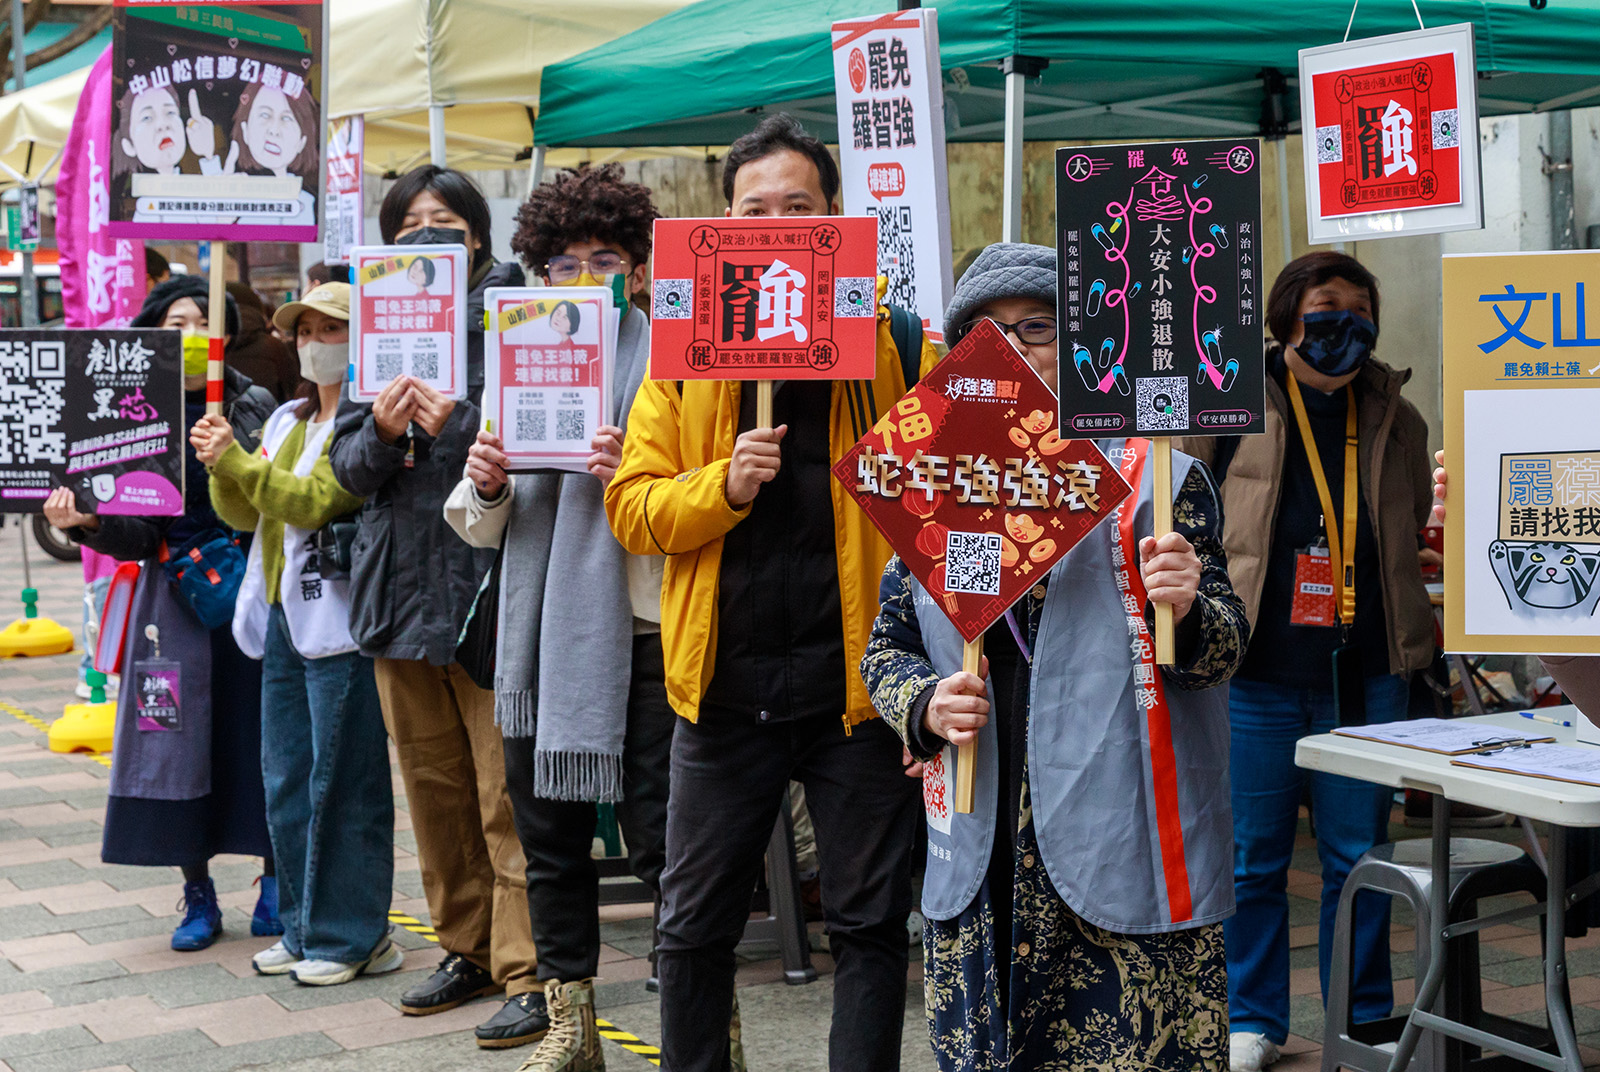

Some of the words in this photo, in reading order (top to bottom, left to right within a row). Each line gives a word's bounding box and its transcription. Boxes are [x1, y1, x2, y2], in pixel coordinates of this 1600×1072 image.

[867, 36, 911, 90] 罷免
[1355, 73, 1411, 91] 政治小強人喊打
[1414, 67, 1428, 86] 安
[1338, 79, 1351, 98] 大
[851, 97, 917, 150] 羅智強
[1070, 158, 1088, 177] 大
[1127, 148, 1189, 168] 罷免
[1232, 150, 1250, 169] 安
[1344, 185, 1356, 204] 罷
[1420, 177, 1434, 196] 強
[694, 229, 715, 251] 大
[722, 233, 808, 246] 政治小強人喊打
[814, 228, 836, 250] 安
[1067, 230, 1080, 332] 罷免就罷羅智強
[1240, 223, 1253, 325] 政治小強人喊打
[699, 273, 711, 326] 劣委滾蛋
[817, 271, 829, 322] 罔顧大安
[1150, 223, 1174, 371] 大安小強退散
[1477, 282, 1600, 354] 文山
[514, 349, 588, 365] 罷免王鴻薇
[691, 345, 711, 366] 罷
[719, 352, 806, 365] 罷免就罷羅智強
[812, 345, 833, 366] 強
[514, 367, 580, 383] 連署找我!
[1504, 361, 1581, 377] 罷免賴士葆
[872, 386, 933, 454] 福
[1076, 418, 1121, 428] 罷免備此符
[1201, 414, 1247, 424] 平安保勝利
[856, 445, 1102, 513] 蛇年強強滾
[1509, 507, 1600, 537] 請找我
